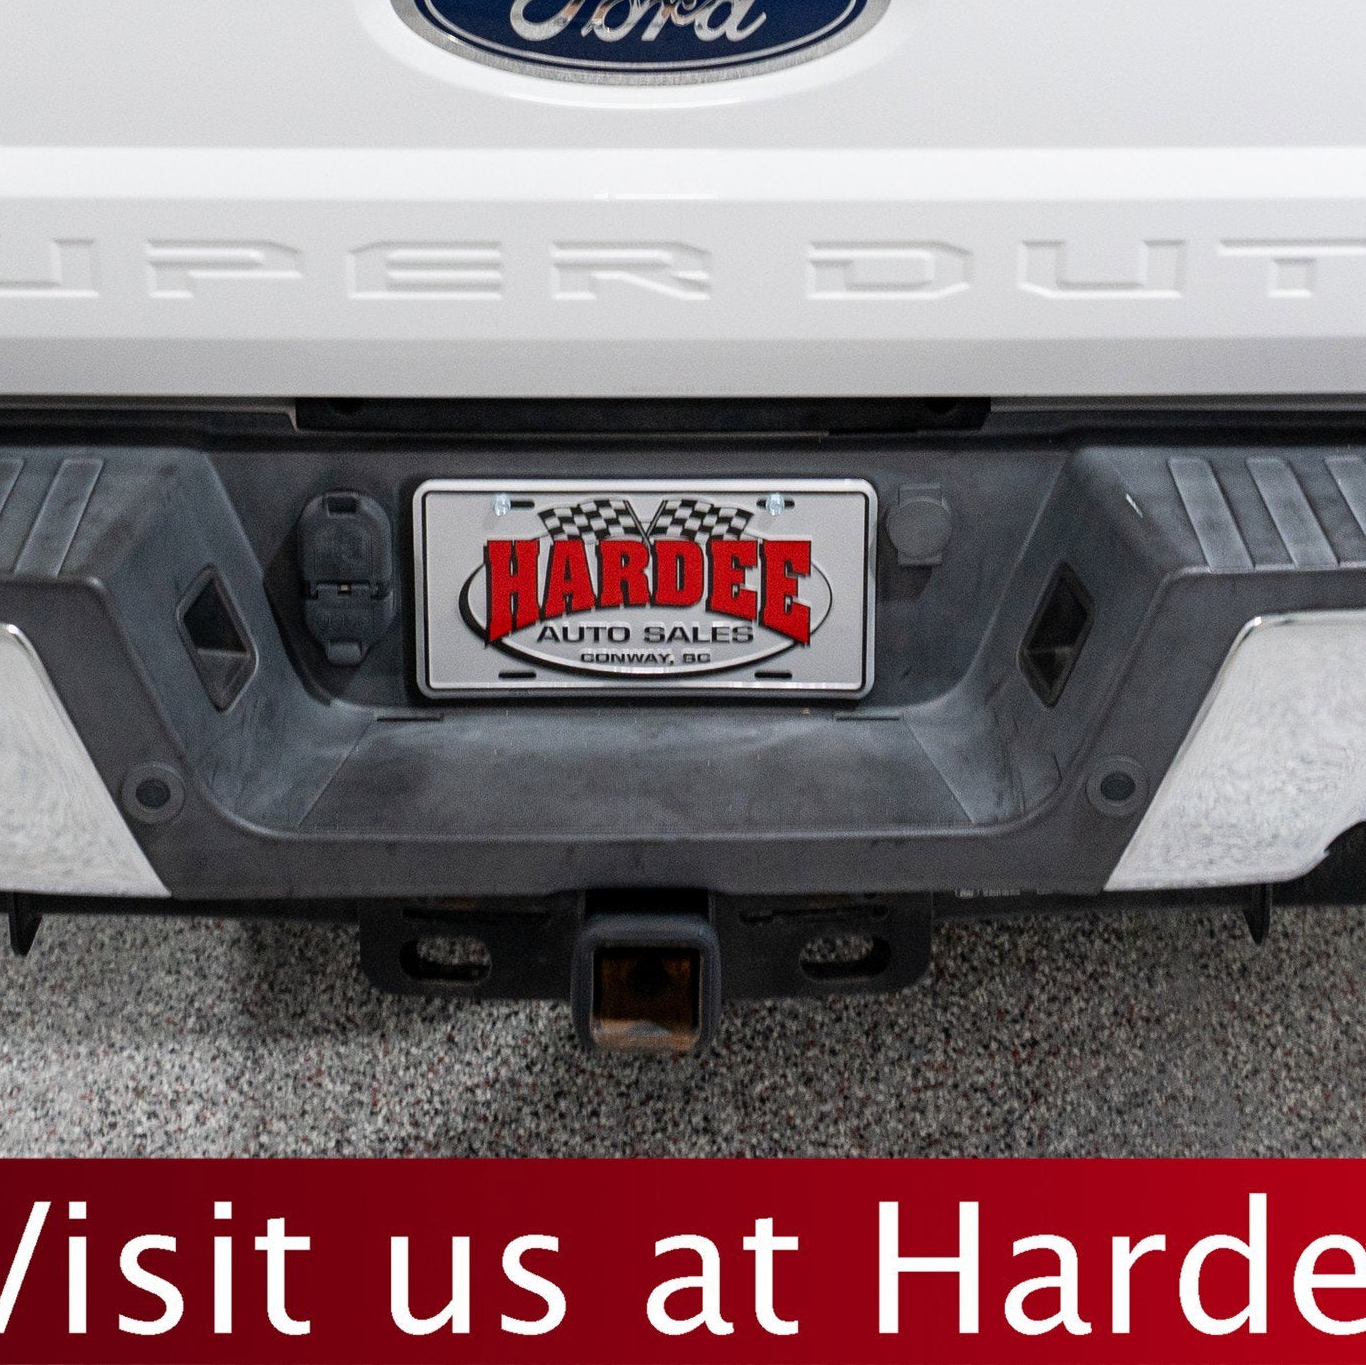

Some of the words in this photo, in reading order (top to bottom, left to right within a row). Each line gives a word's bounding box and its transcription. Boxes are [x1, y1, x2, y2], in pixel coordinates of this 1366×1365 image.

[483, 539, 811, 646] HARDEE
[537, 623, 632, 644] AUTO
[643, 623, 754, 644] SALES
[580, 651, 676, 666] CONWAY,
[682, 651, 711, 665] SC
